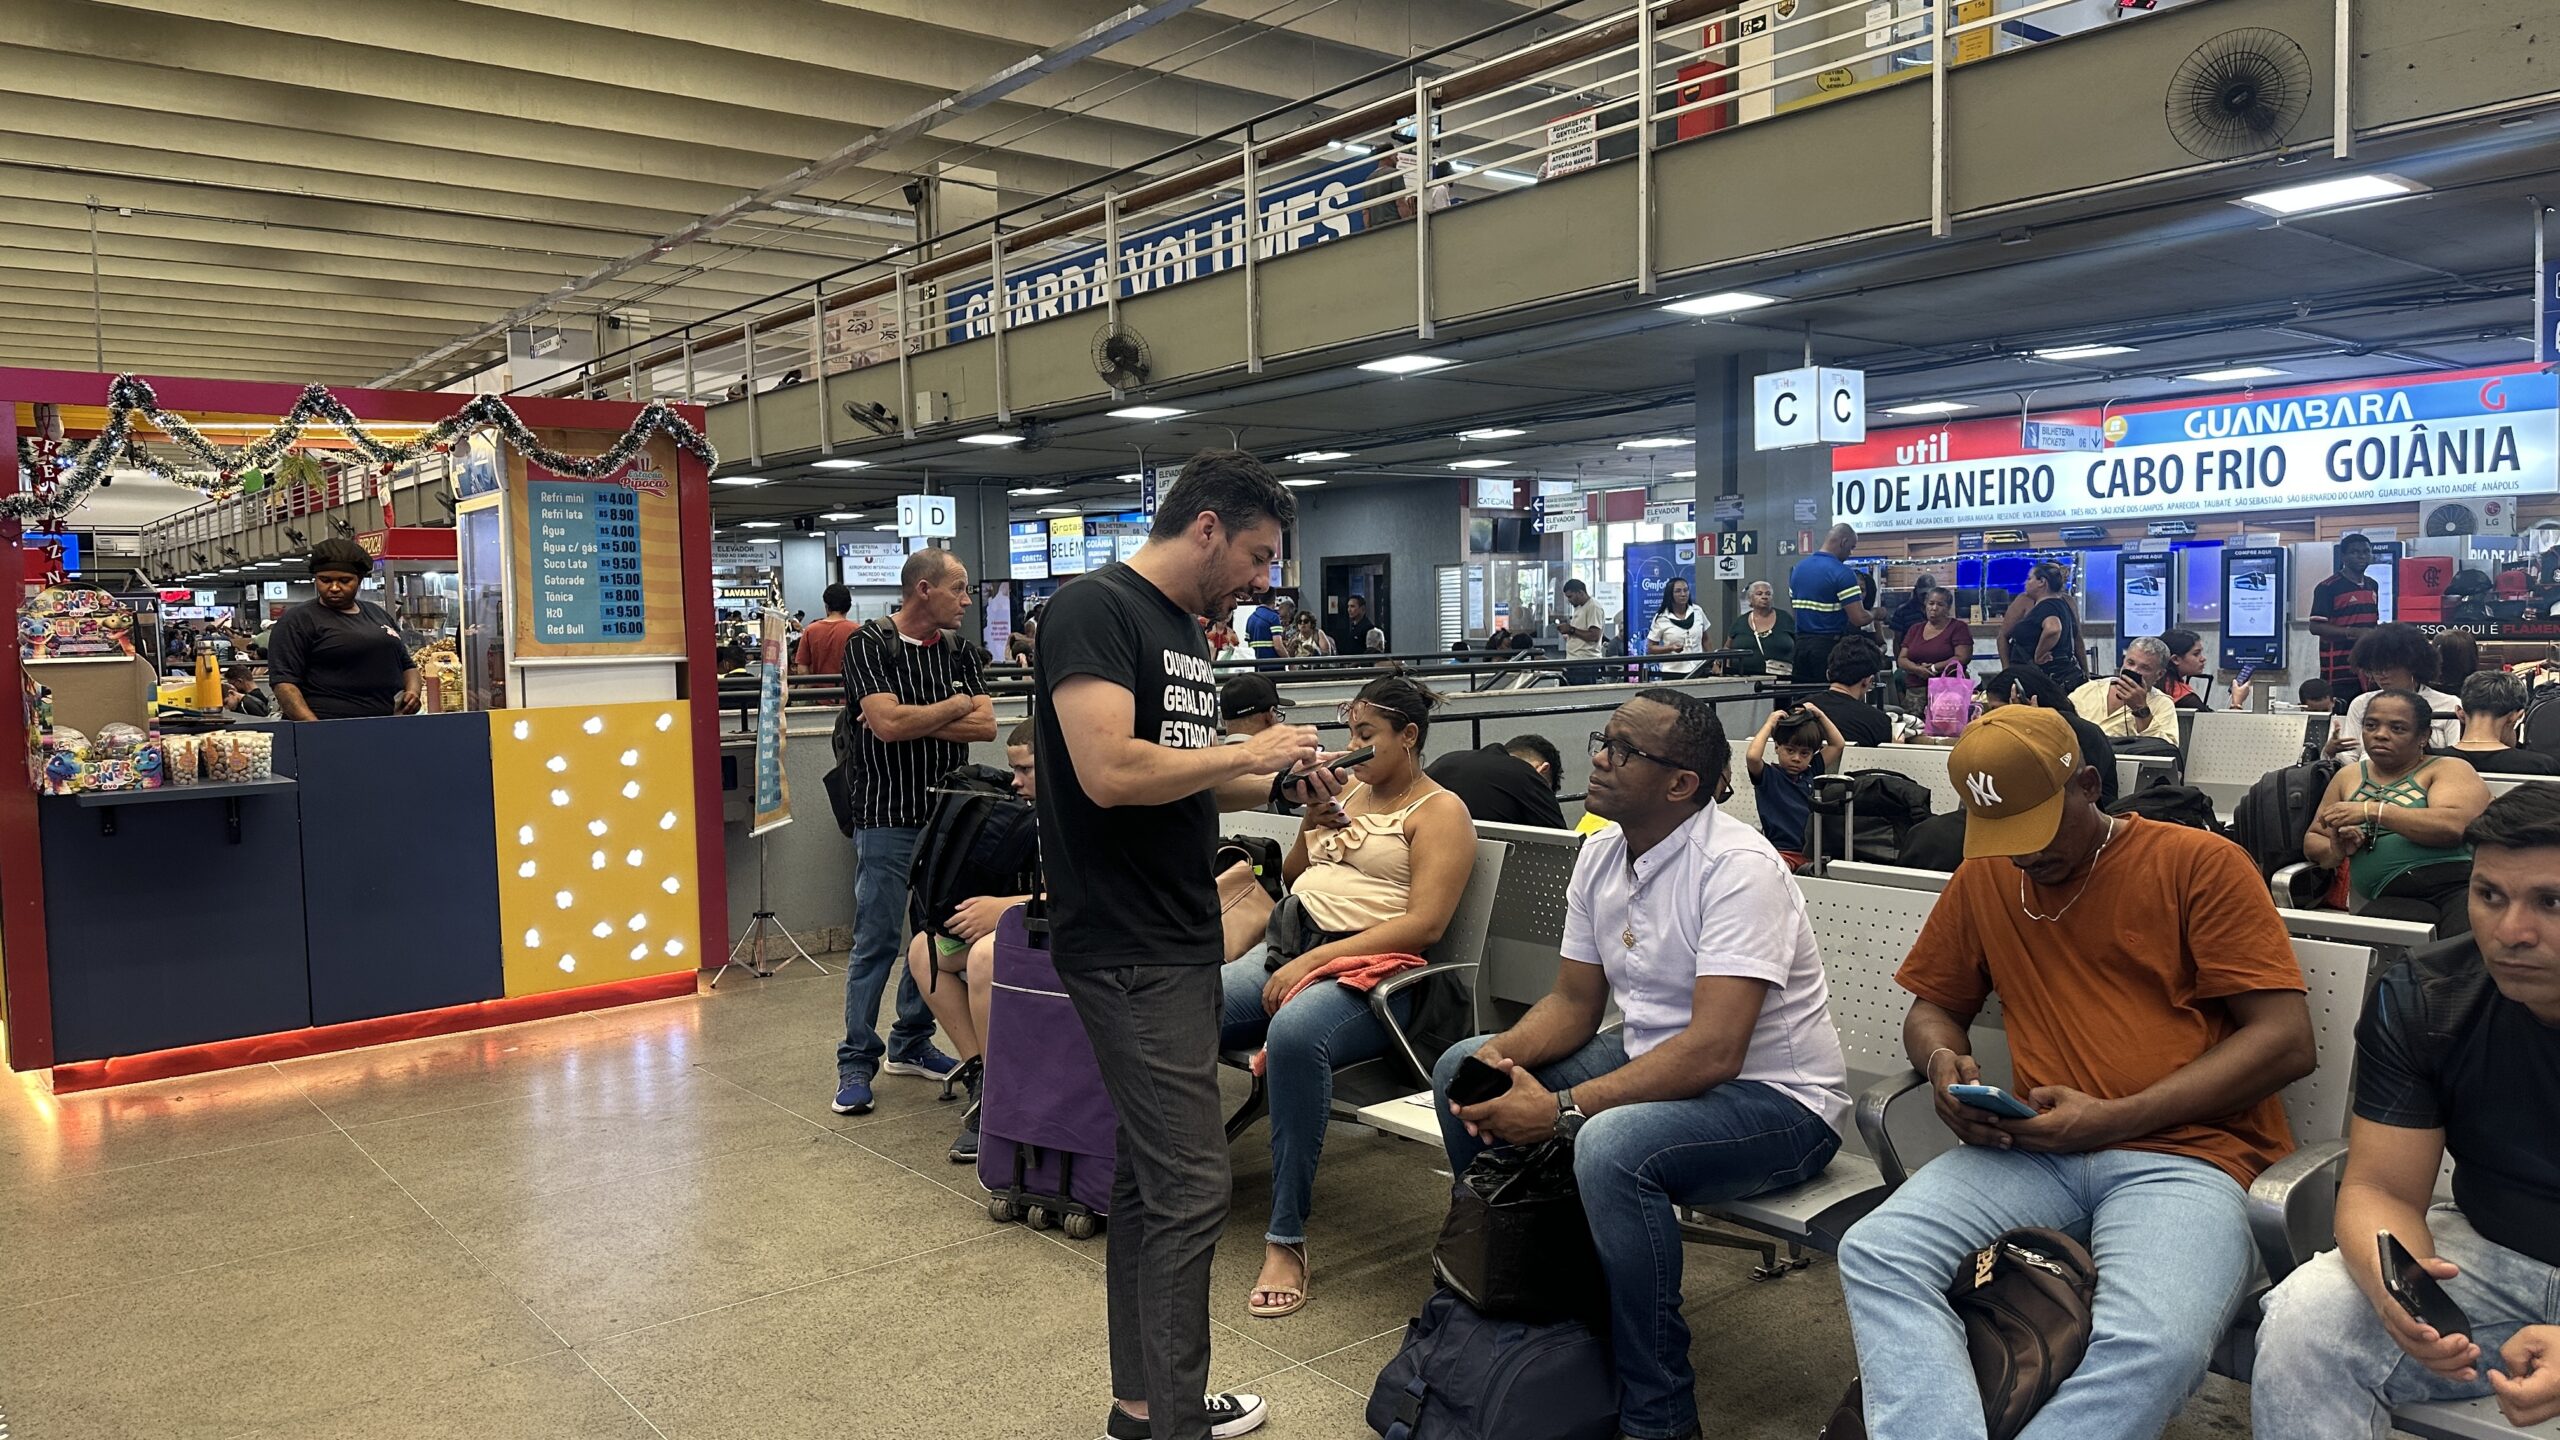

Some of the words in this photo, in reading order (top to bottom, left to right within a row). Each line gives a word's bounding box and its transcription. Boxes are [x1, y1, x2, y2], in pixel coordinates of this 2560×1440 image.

[1774, 392, 1798, 426] C
[1834, 389, 1851, 423] C
[2184, 391, 2414, 439] GUANABARA
[2042, 427, 2074, 436] BILHETERIA
[1896, 432, 1948, 465] util
[2042, 437, 2066, 446] TICKETS
[2079, 438, 2086, 448] 06
[628, 470, 663, 480] Estação
[1832, 479, 1865, 516] IO
[1874, 476, 1911, 514] DE
[1917, 464, 2055, 510] JANEIRO
[2087, 454, 2184, 499] CABO
[2196, 445, 2286, 492] FRIO
[2326, 423, 2521, 483] GOIÂNIA
[619, 477, 671, 490] Pipocas
[541, 491, 563, 502] Refri
[565, 493, 584, 503] mini
[609, 493, 633, 505] 4.00
[1478, 497, 1512, 506] CATEDRAL
[2139, 504, 2163, 512] CAMPOS
[2167, 501, 2200, 510] APARECIDA
[2204, 498, 2231, 508] TAUBATÉ
[2235, 497, 2248, 506] SÃO
[2249, 495, 2283, 505] SEBASTIÃO
[2287, 494, 2300, 503] SÃO
[2301, 492, 2336, 502] BERNARDO
[2338, 492, 2348, 500] DO
[2349, 490, 2374, 499] CAMPO
[2378, 487, 2422, 498] GUARULHOS
[2426, 485, 2450, 495] SANTO
[2452, 482, 2476, 493] ANDRÉ
[2482, 480, 2519, 491] ANÁPOLIS
[542, 508, 564, 520] Refri
[566, 509, 583, 520] lata
[610, 508, 634, 521] 8.90
[904, 507, 913, 525] D
[931, 507, 945, 525] D
[1647, 506, 1680, 516] ELEVADOR
[1546, 516, 1576, 524] ELEVADOR
[2486, 518, 2498, 526] LG
[542, 524, 565, 537] Água
[611, 525, 634, 538] 4.00
[543, 539, 566, 554] Água
[569, 542, 578, 552] c/
[580, 542, 598, 554] gás
[612, 541, 636, 553] 5.00
[1052, 538, 1084, 558] BELÉM
[544, 559, 565, 569] Suco
[569, 559, 588, 569] Lata
[612, 557, 636, 570] 9.50
[544, 575, 585, 586] Gatorade
[611, 573, 640, 586] 15.00
[53, 590, 96, 600] DIVER
[274, 586, 282, 595] G
[545, 590, 574, 602] Tônica
[615, 590, 639, 602] 8.00
[724, 589, 766, 597] BAVARIAN
[546, 608, 563, 618] H2O
[616, 605, 640, 617] 9.50
[547, 624, 564, 635] Red
[567, 624, 584, 635] Bull
[613, 621, 643, 634] 16.00
[2417, 624, 2446, 635] SSO
[2491, 622, 2499, 634] É
[1164, 684, 1199, 715] GERAL
[1199, 690, 1214, 718] DO
[1159, 720, 1207, 748] ESTADO
[84, 761, 131, 774] DIVER
[1965, 771, 2003, 807] NY
